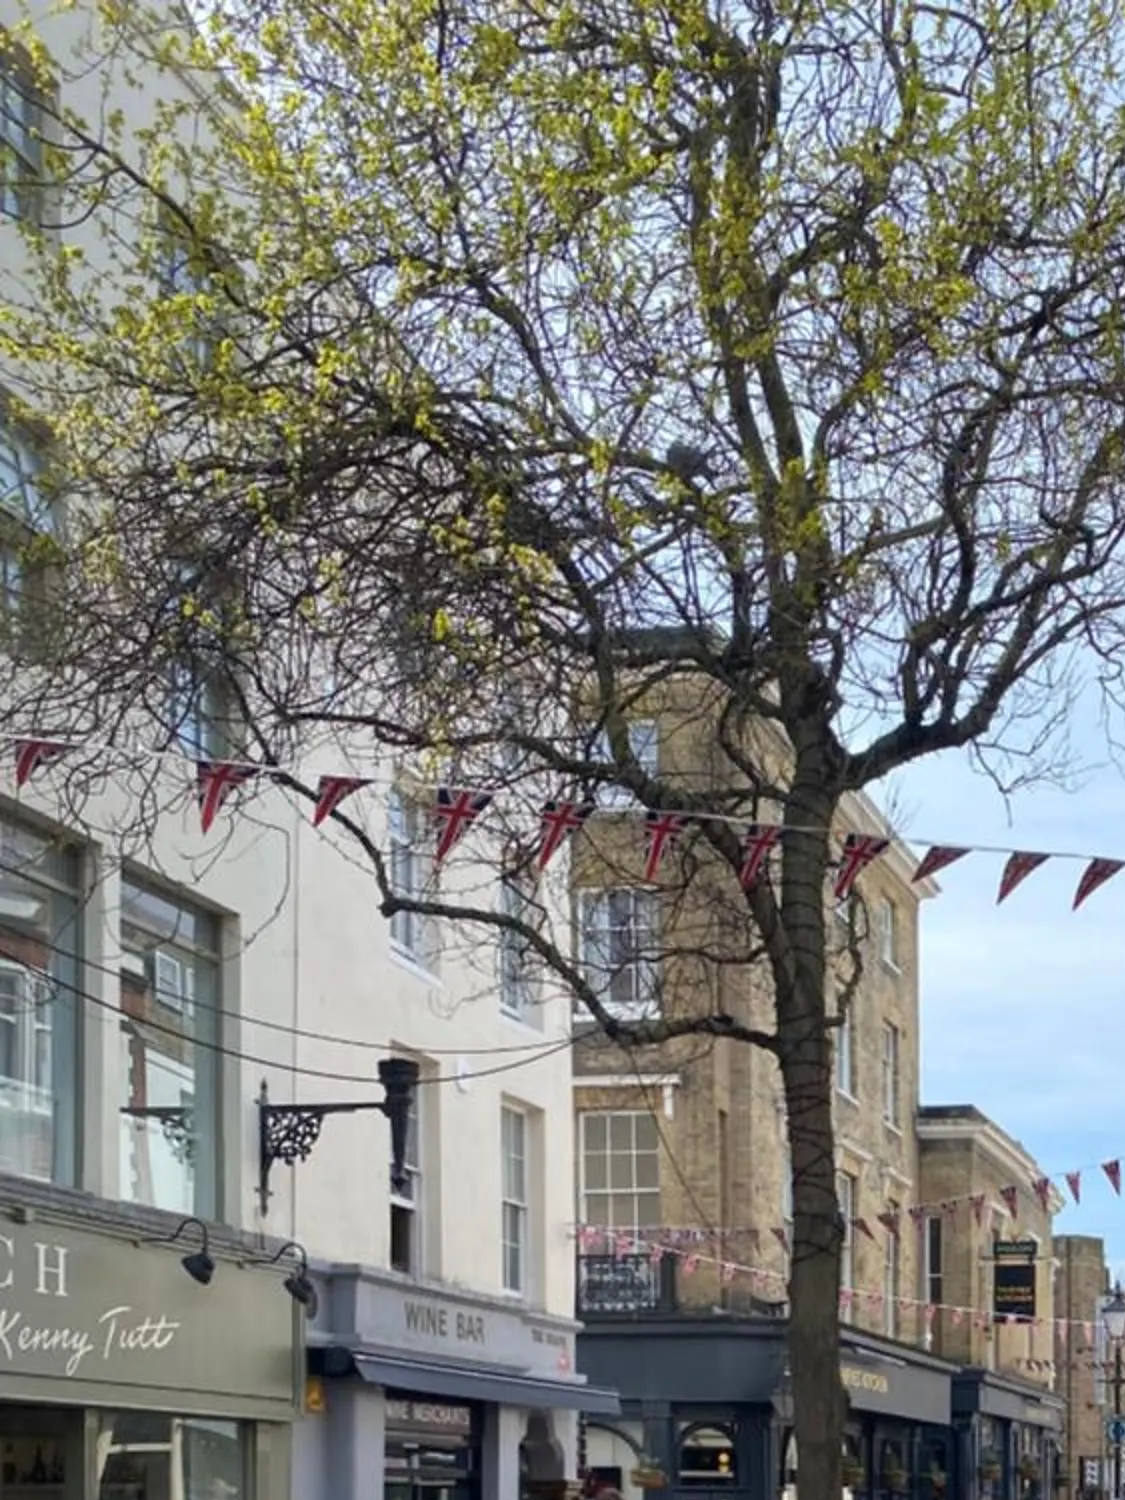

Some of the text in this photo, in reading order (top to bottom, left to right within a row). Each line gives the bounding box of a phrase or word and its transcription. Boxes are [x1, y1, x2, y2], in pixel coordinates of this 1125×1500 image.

[0, 1305, 181, 1377] Kenny Tutt
[404, 1301, 486, 1346] WINE BAR
